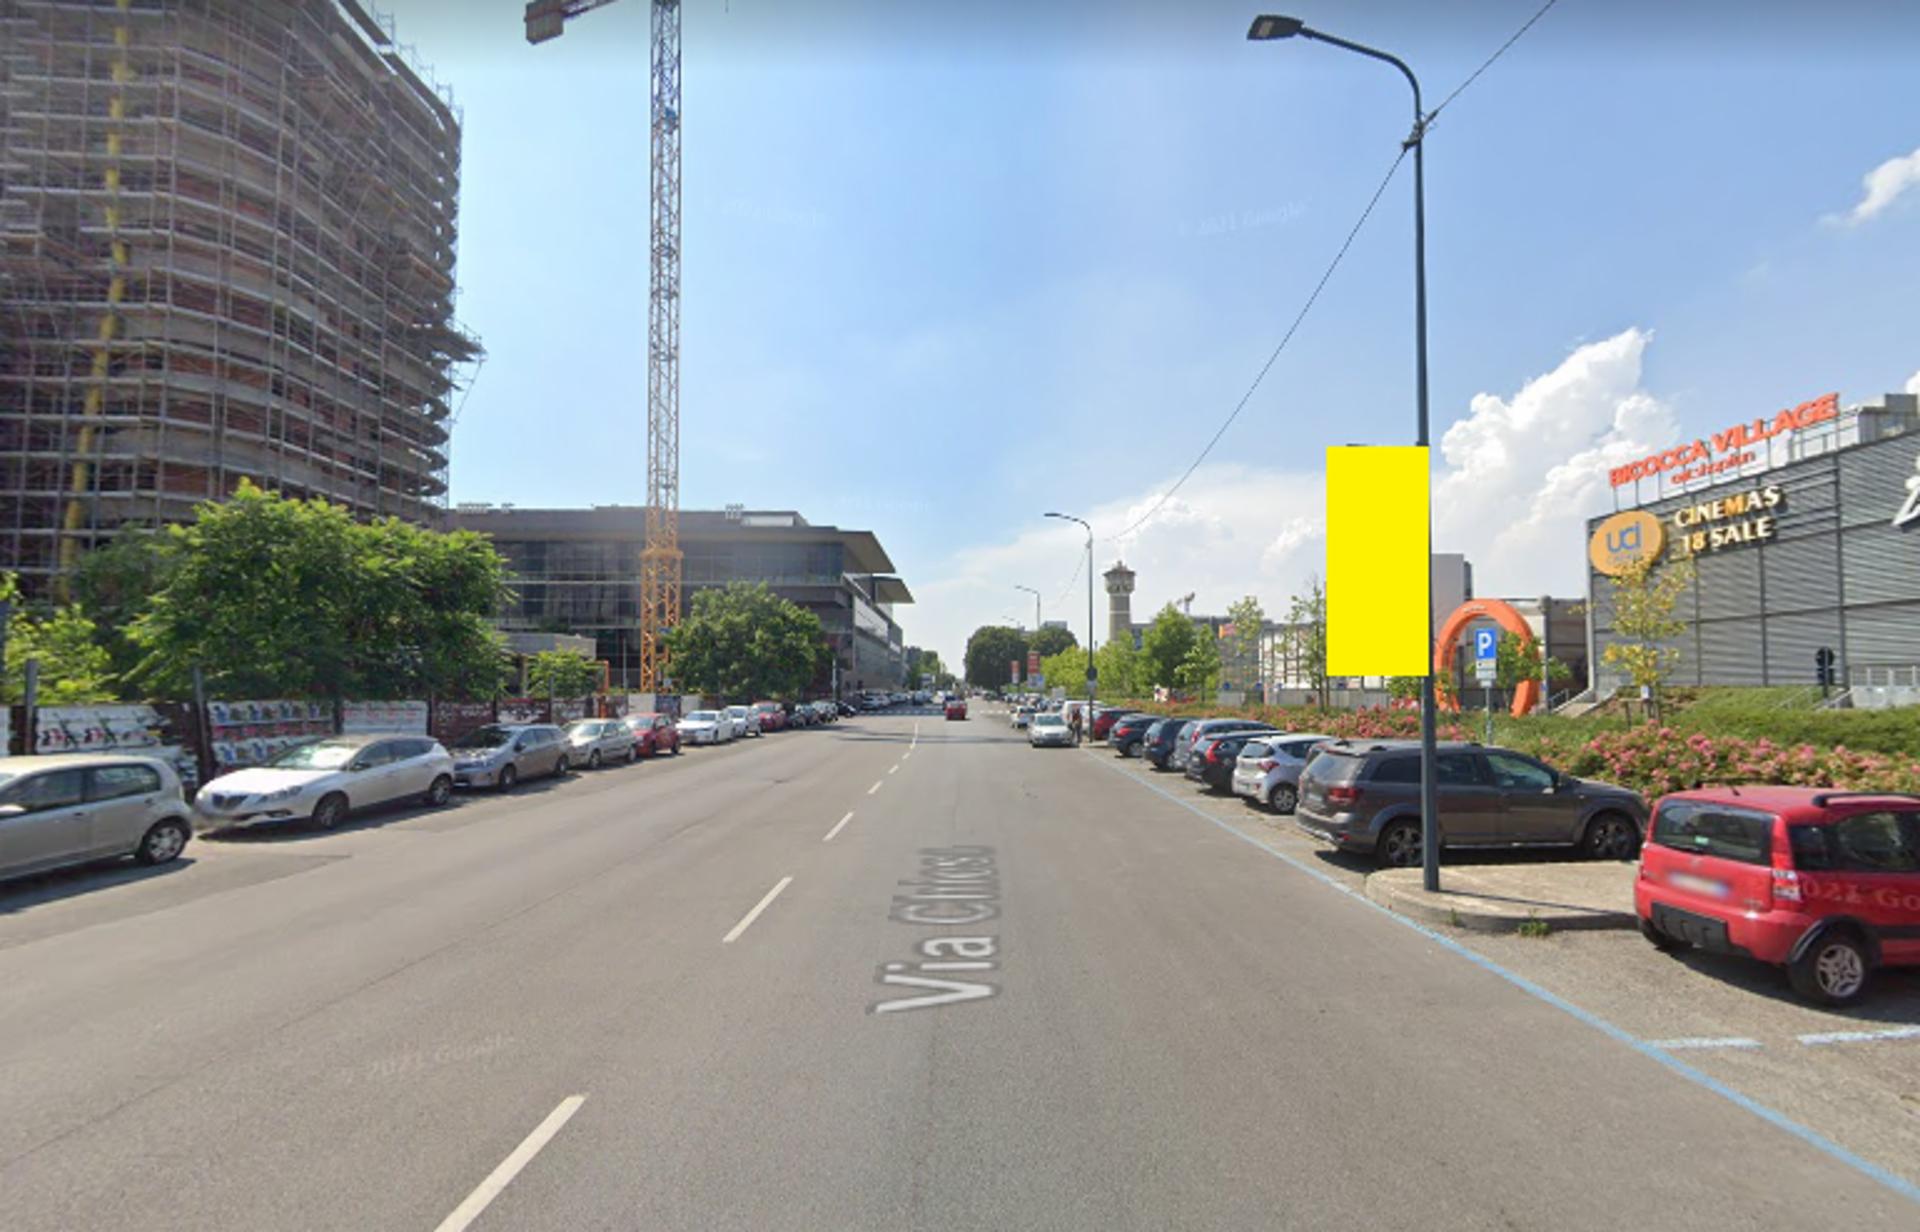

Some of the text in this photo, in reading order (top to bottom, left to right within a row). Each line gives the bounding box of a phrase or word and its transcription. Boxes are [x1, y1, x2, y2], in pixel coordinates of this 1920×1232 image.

[1609, 438, 1711, 487] BICOCCA
[1711, 392, 1840, 452] VILLAGE
[1674, 485, 1783, 528] CINEMAS
[1682, 516, 1773, 552] 18 SALE
[1478, 632, 1492, 657] P
